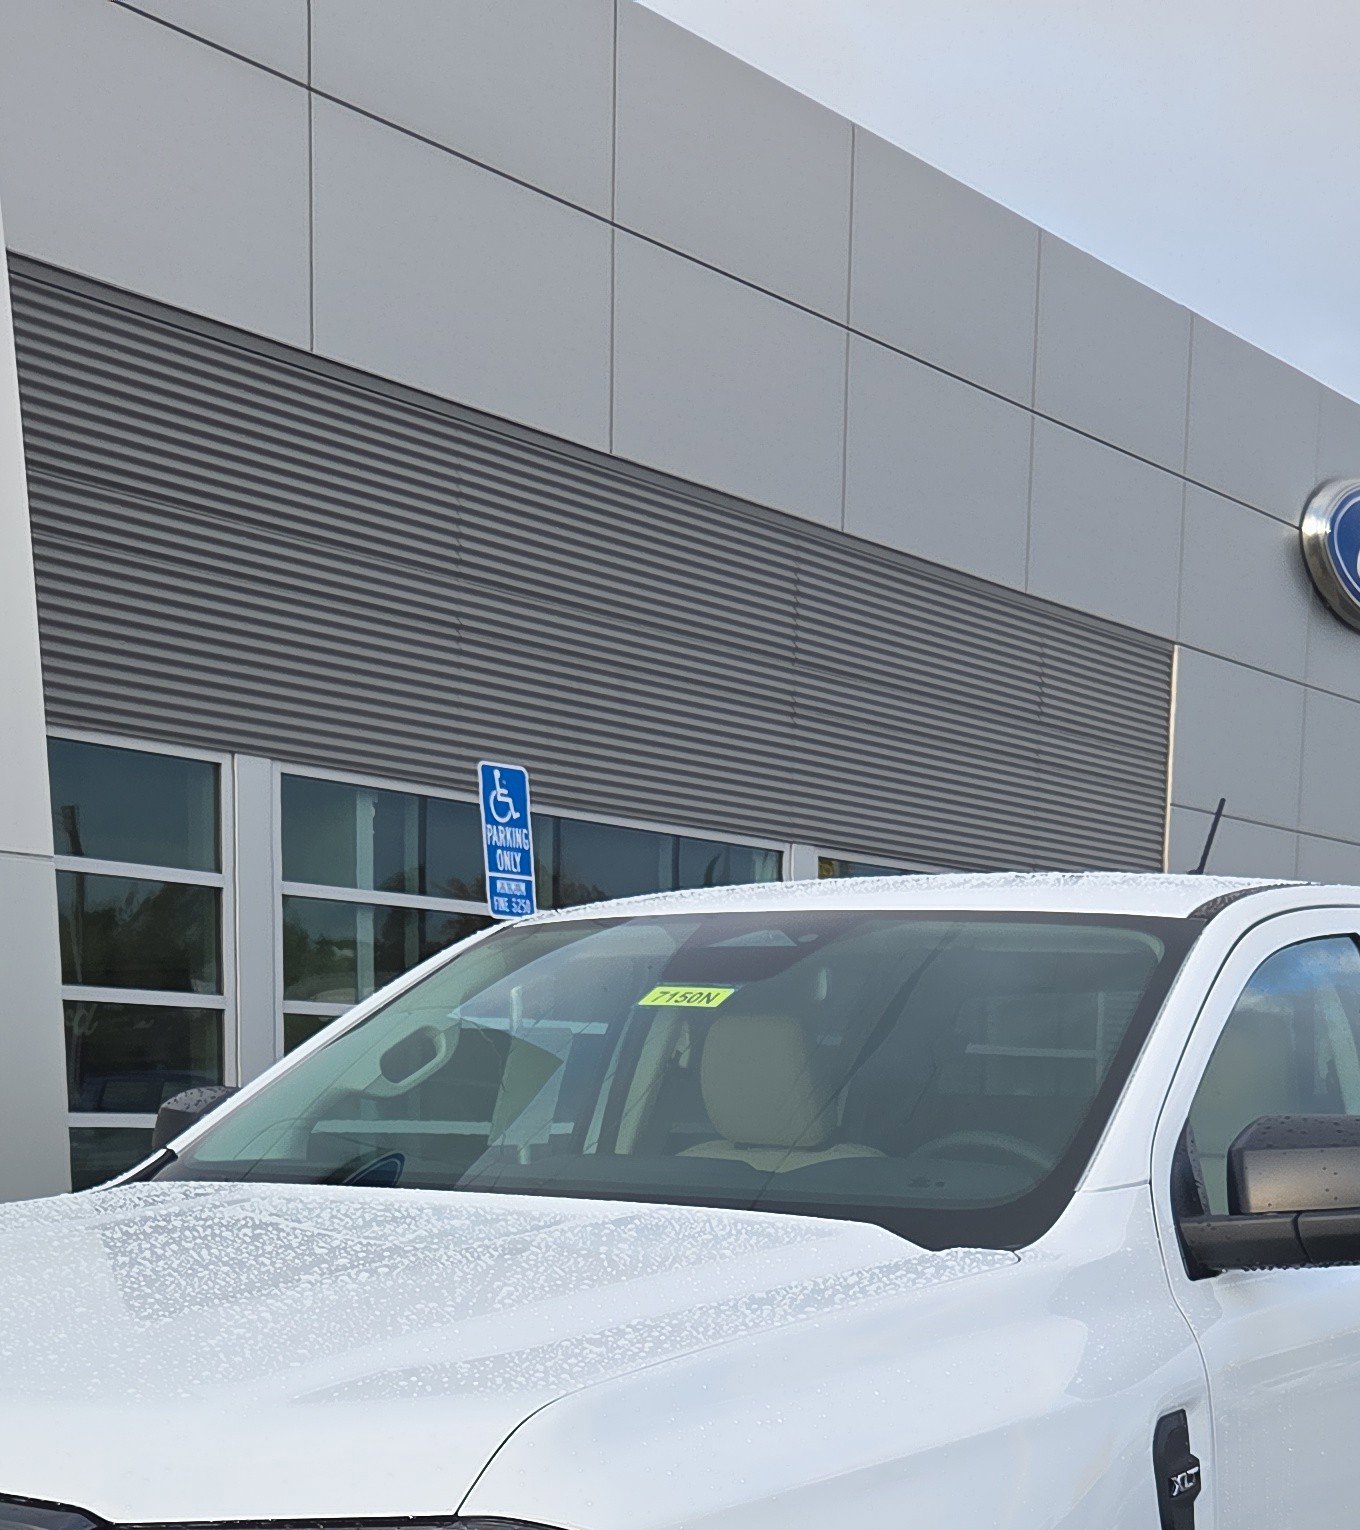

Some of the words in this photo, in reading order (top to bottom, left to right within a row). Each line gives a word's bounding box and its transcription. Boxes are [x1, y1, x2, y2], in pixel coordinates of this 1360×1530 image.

[486, 824, 530, 851] PARKING
[495, 848, 522, 873] ONLY
[651, 990, 720, 1005] 7150N
[1170, 1466, 1199, 1496] XLT
